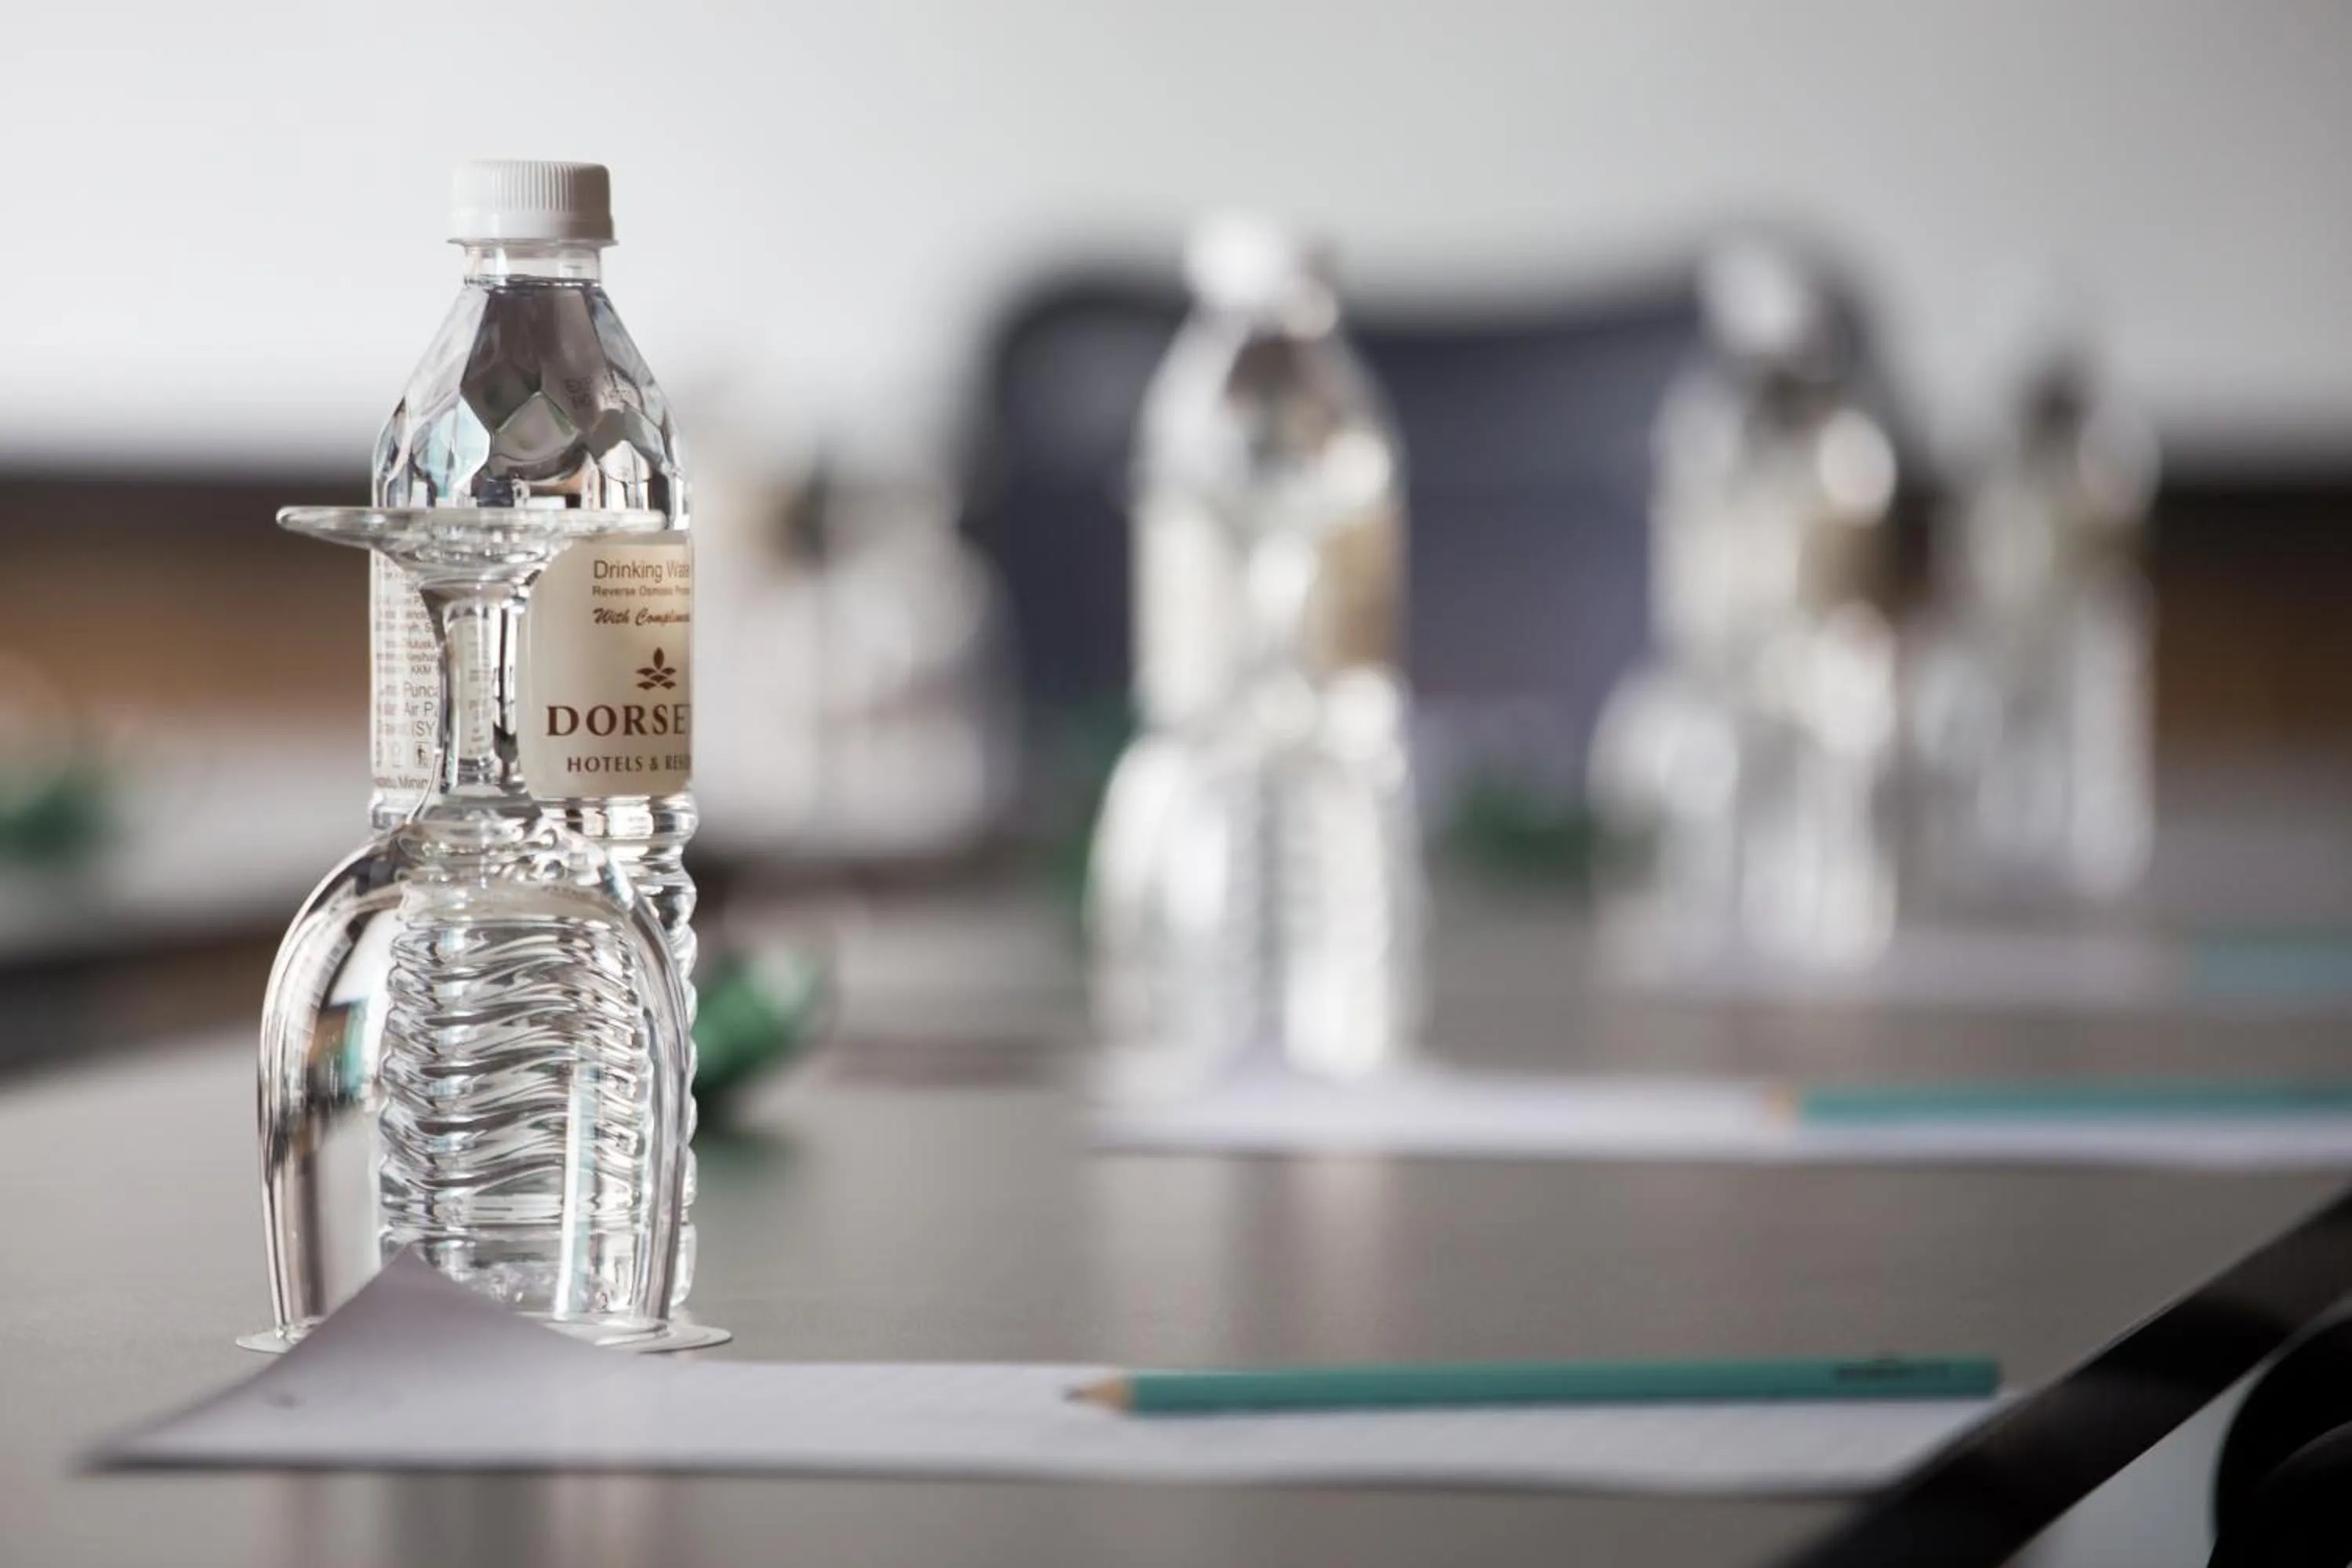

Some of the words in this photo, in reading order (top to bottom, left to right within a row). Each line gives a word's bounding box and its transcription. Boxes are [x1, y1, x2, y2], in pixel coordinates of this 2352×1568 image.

[593, 560, 662, 583] Drinking
[593, 608, 630, 624] With
[546, 703, 691, 736] DORSE
[567, 756, 644, 772] HOTELS
[649, 756, 659, 772] &
